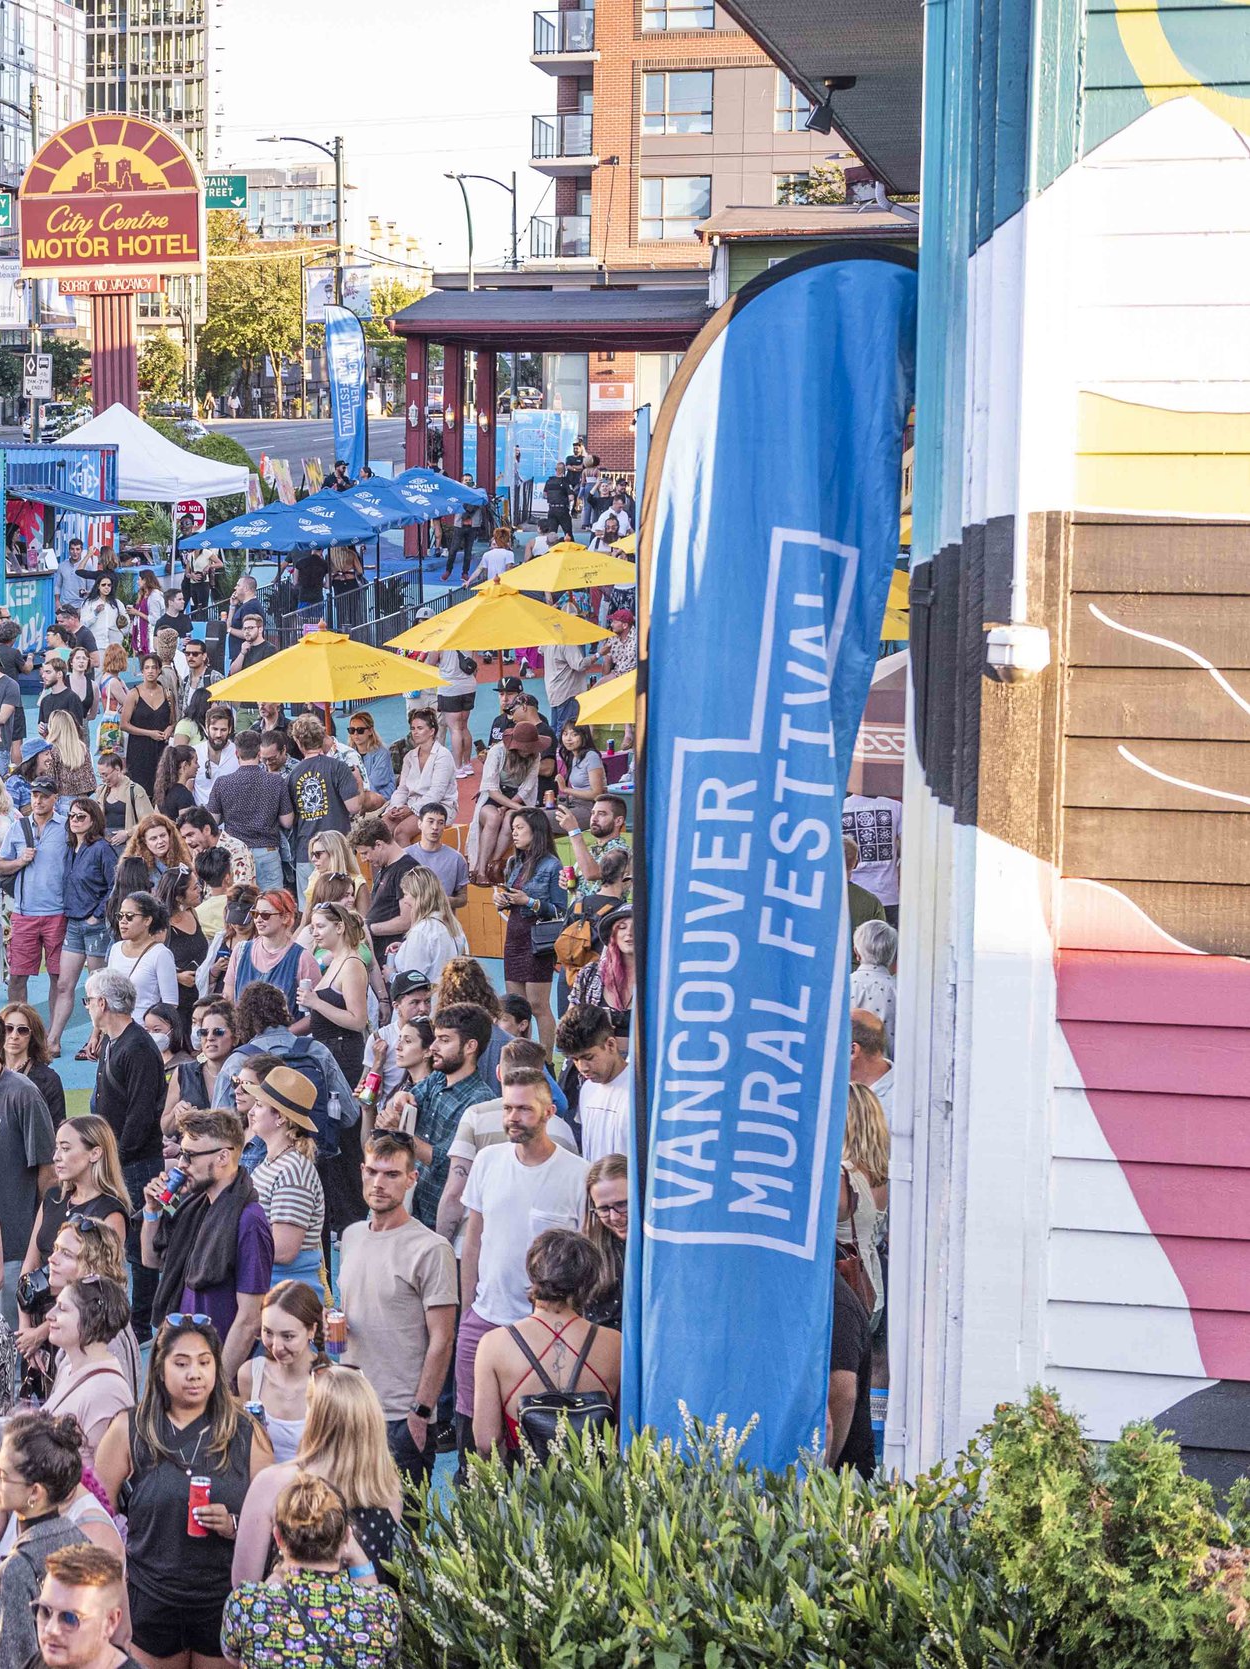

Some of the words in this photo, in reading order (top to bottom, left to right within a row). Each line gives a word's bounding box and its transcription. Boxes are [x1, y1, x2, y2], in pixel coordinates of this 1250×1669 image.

[204, 187, 234, 197] TREET
[46, 205, 94, 238] City
[99, 203, 169, 232] Centre
[26, 236, 109, 260] MOTOR
[118, 234, 197, 256] HOTEL
[61, 280, 91, 292] SORRY
[94, 280, 108, 291] NO
[110, 278, 152, 290] VACANCY
[340, 381, 352, 433] FESTIVAL
[653, 776, 758, 1210] VANCOUVER
[728, 984, 814, 1219] MURAL
